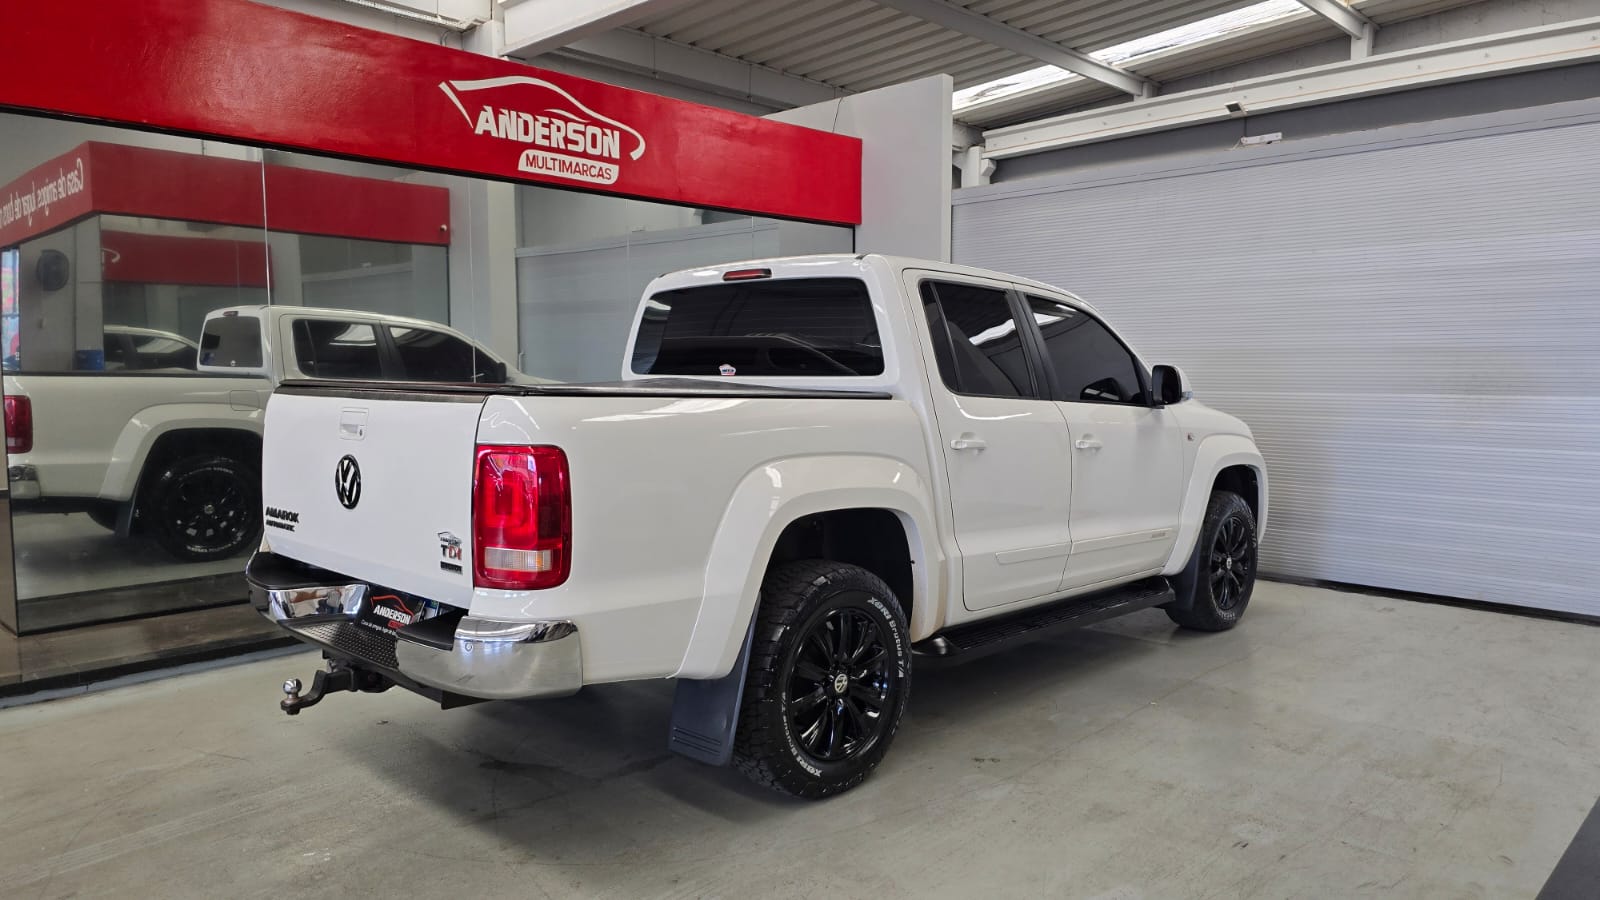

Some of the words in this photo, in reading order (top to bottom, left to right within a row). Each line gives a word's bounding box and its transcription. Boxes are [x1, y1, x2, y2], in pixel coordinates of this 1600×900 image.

[474, 105, 620, 159] ANDERSON
[525, 152, 612, 180] MULTIMARCAS
[372, 604, 412, 625] ANDERSON
